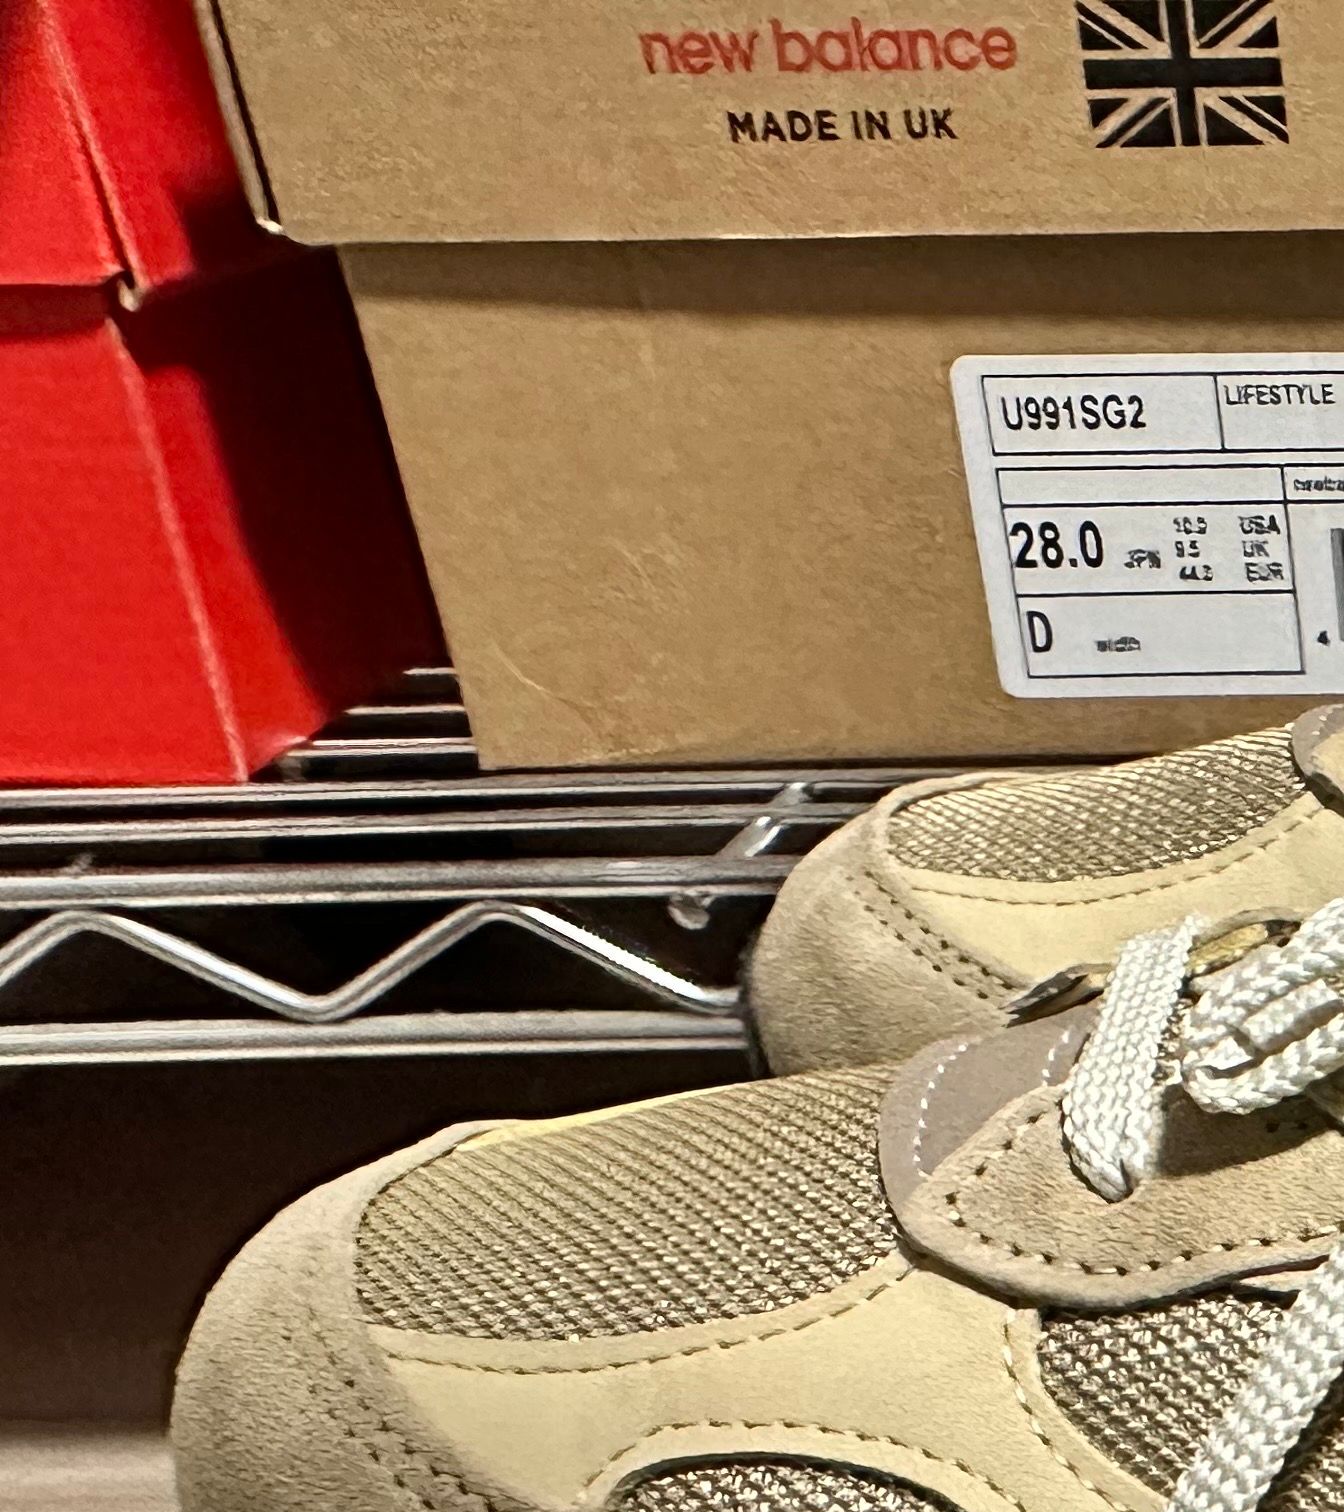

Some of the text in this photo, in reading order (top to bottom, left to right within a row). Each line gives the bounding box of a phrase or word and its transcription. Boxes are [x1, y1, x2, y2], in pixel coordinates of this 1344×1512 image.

[640, 18, 1017, 76] new balance
[727, 108, 957, 143] MADE IN UK
[1003, 395, 1146, 431] U991SG2
[1224, 383, 1335, 406] LIFESTYLE
[1009, 520, 1104, 569] 28.0
[1026, 610, 1053, 653] D
